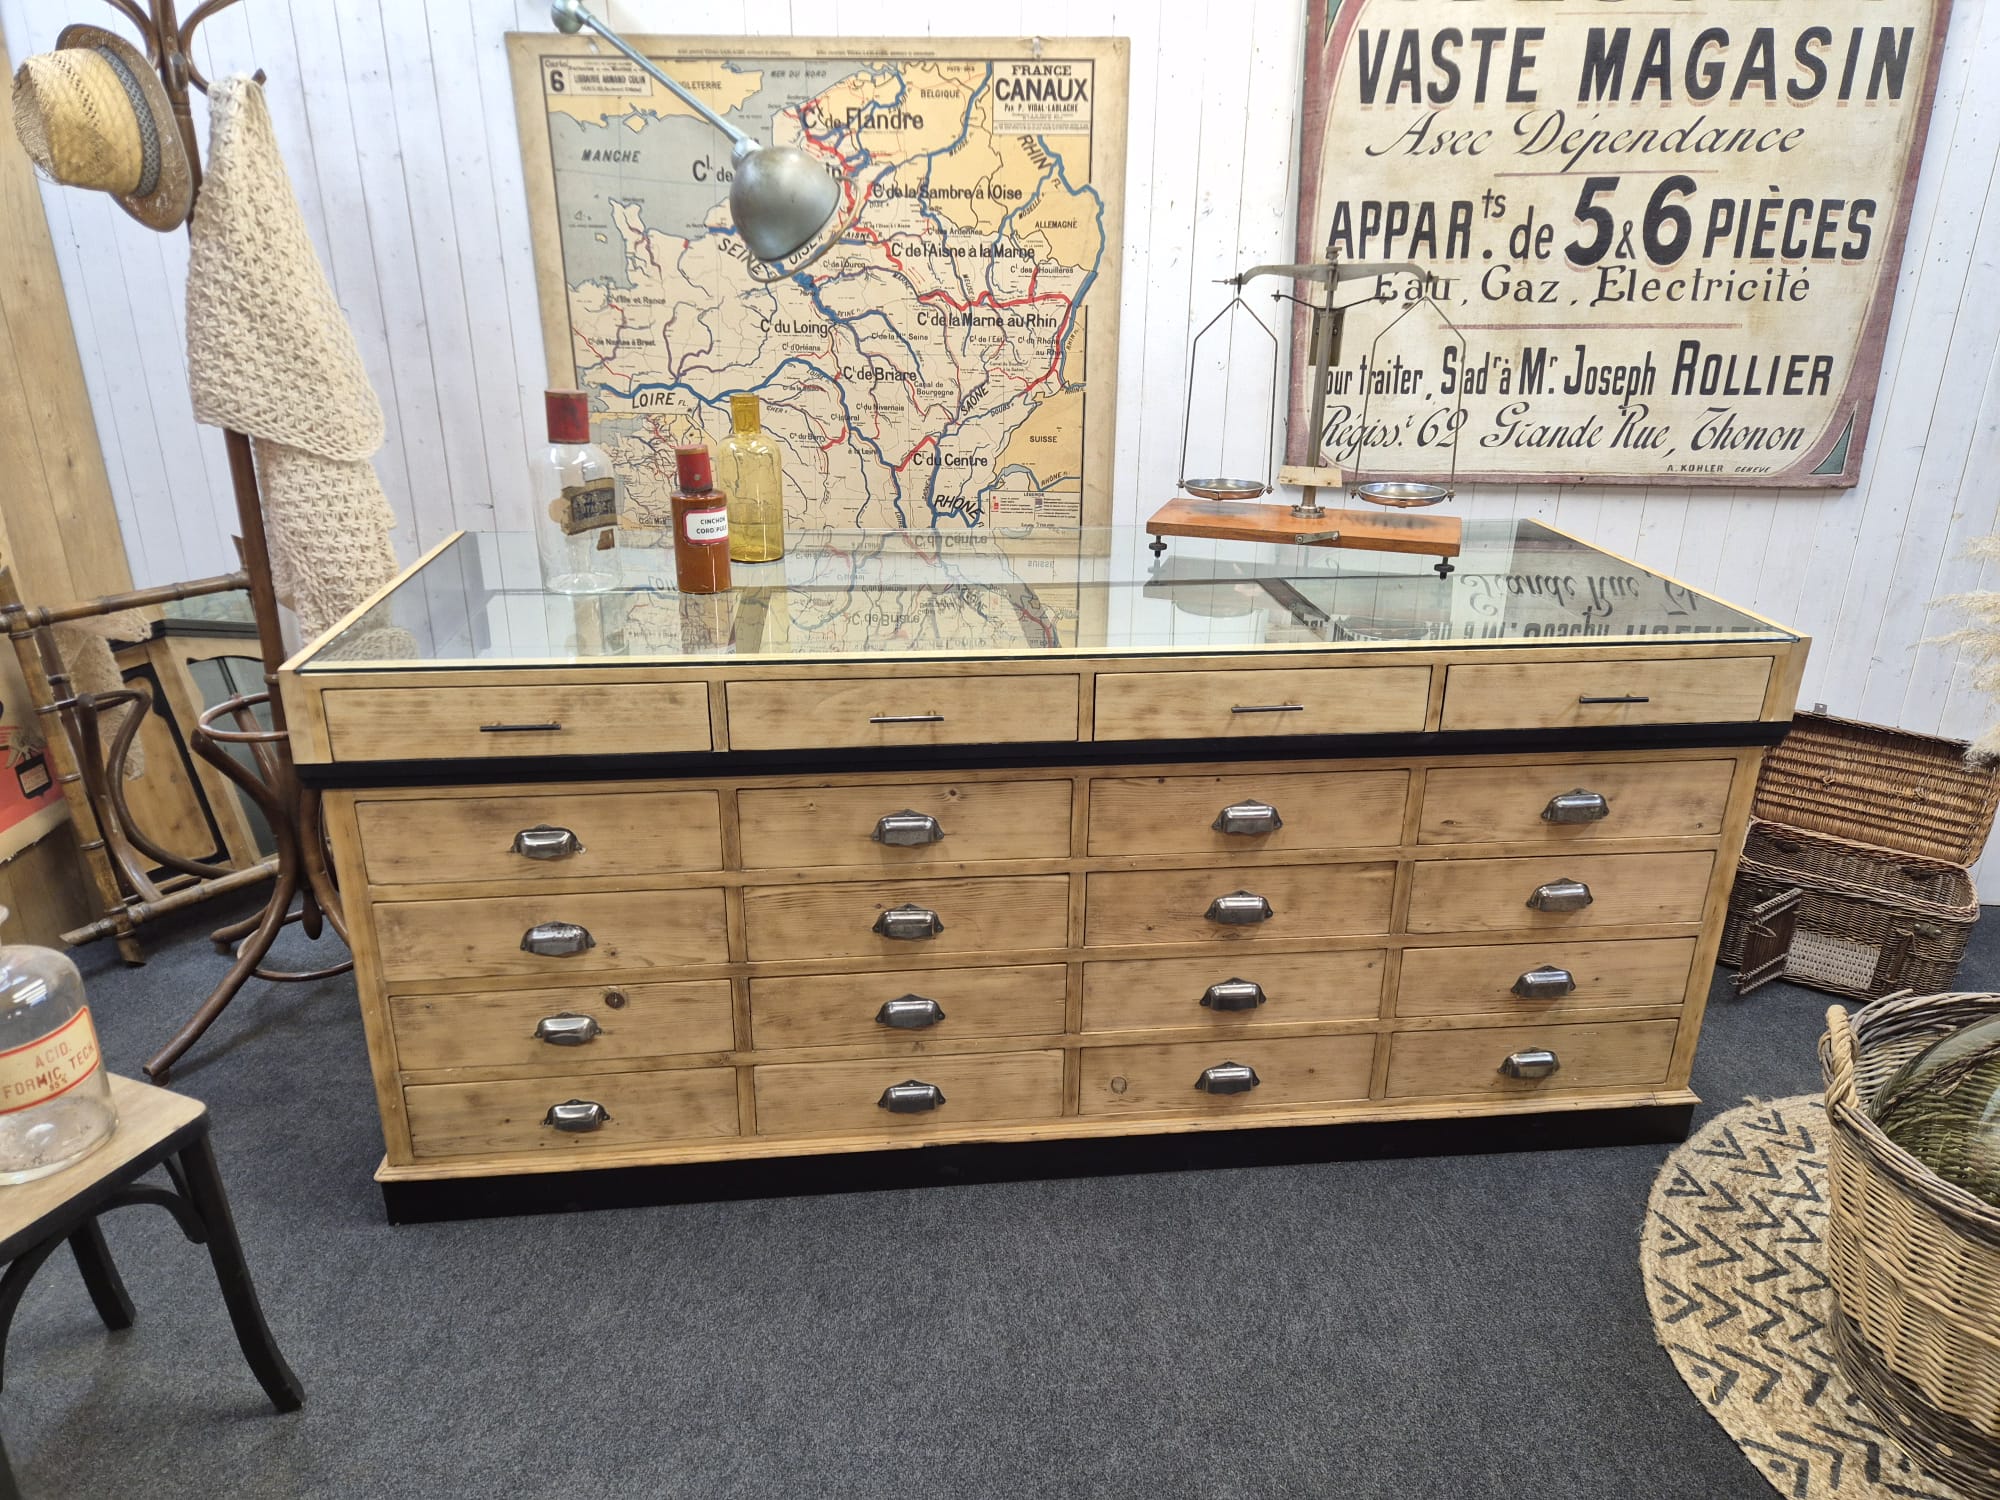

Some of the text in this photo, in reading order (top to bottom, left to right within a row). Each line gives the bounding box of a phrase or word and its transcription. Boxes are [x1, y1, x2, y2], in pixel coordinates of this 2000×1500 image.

[1011, 65, 1072, 76] FRANCE
[1358, 26, 1915, 105] VASTE MAGASIN
[550, 69, 565, 92] 6
[995, 78, 1088, 101] CANAUX
[920, 89, 960, 98] BELGIQUE
[846, 107, 924, 129] Flandre
[1513, 109, 1805, 173] Dépendance
[581, 149, 641, 163] MANCHE
[1017, 134, 1052, 170] RHIN
[920, 184, 974, 199] Sambre
[975, 186, 984, 199] à
[1034, 220, 1078, 229] ALLEMAGNE
[1509, 205, 1554, 260] de
[1702, 185, 1877, 260] PIÈCES
[905, 243, 920, 257] de
[923, 243, 965, 258] l'Aisne
[968, 245, 977, 258] à
[980, 243, 993, 258] la
[994, 245, 1035, 258] Marne
[774, 319, 829, 338] du Loing
[931, 312, 946, 327] de
[948, 312, 959, 327] la
[961, 312, 1004, 327] Marne
[1007, 315, 1024, 328] au
[1026, 313, 1057, 327] Rhin
[857, 366, 873, 380] de
[875, 367, 917, 381] Briare
[1325, 369, 1353, 395] our
[1499, 358, 1512, 396] à
[1563, 345, 1657, 416] Joseph
[1671, 340, 1834, 396] ROLLIER
[631, 392, 676, 409] LOIRE
[1417, 407, 1468, 448] 62
[1480, 401, 1604, 449] Grande
[1690, 403, 1807, 451] Thonon
[1029, 435, 1058, 443] SUISSE
[926, 453, 941, 466] du
[944, 453, 988, 467] Centre
[2, 1066, 62, 1099] FORMIC
